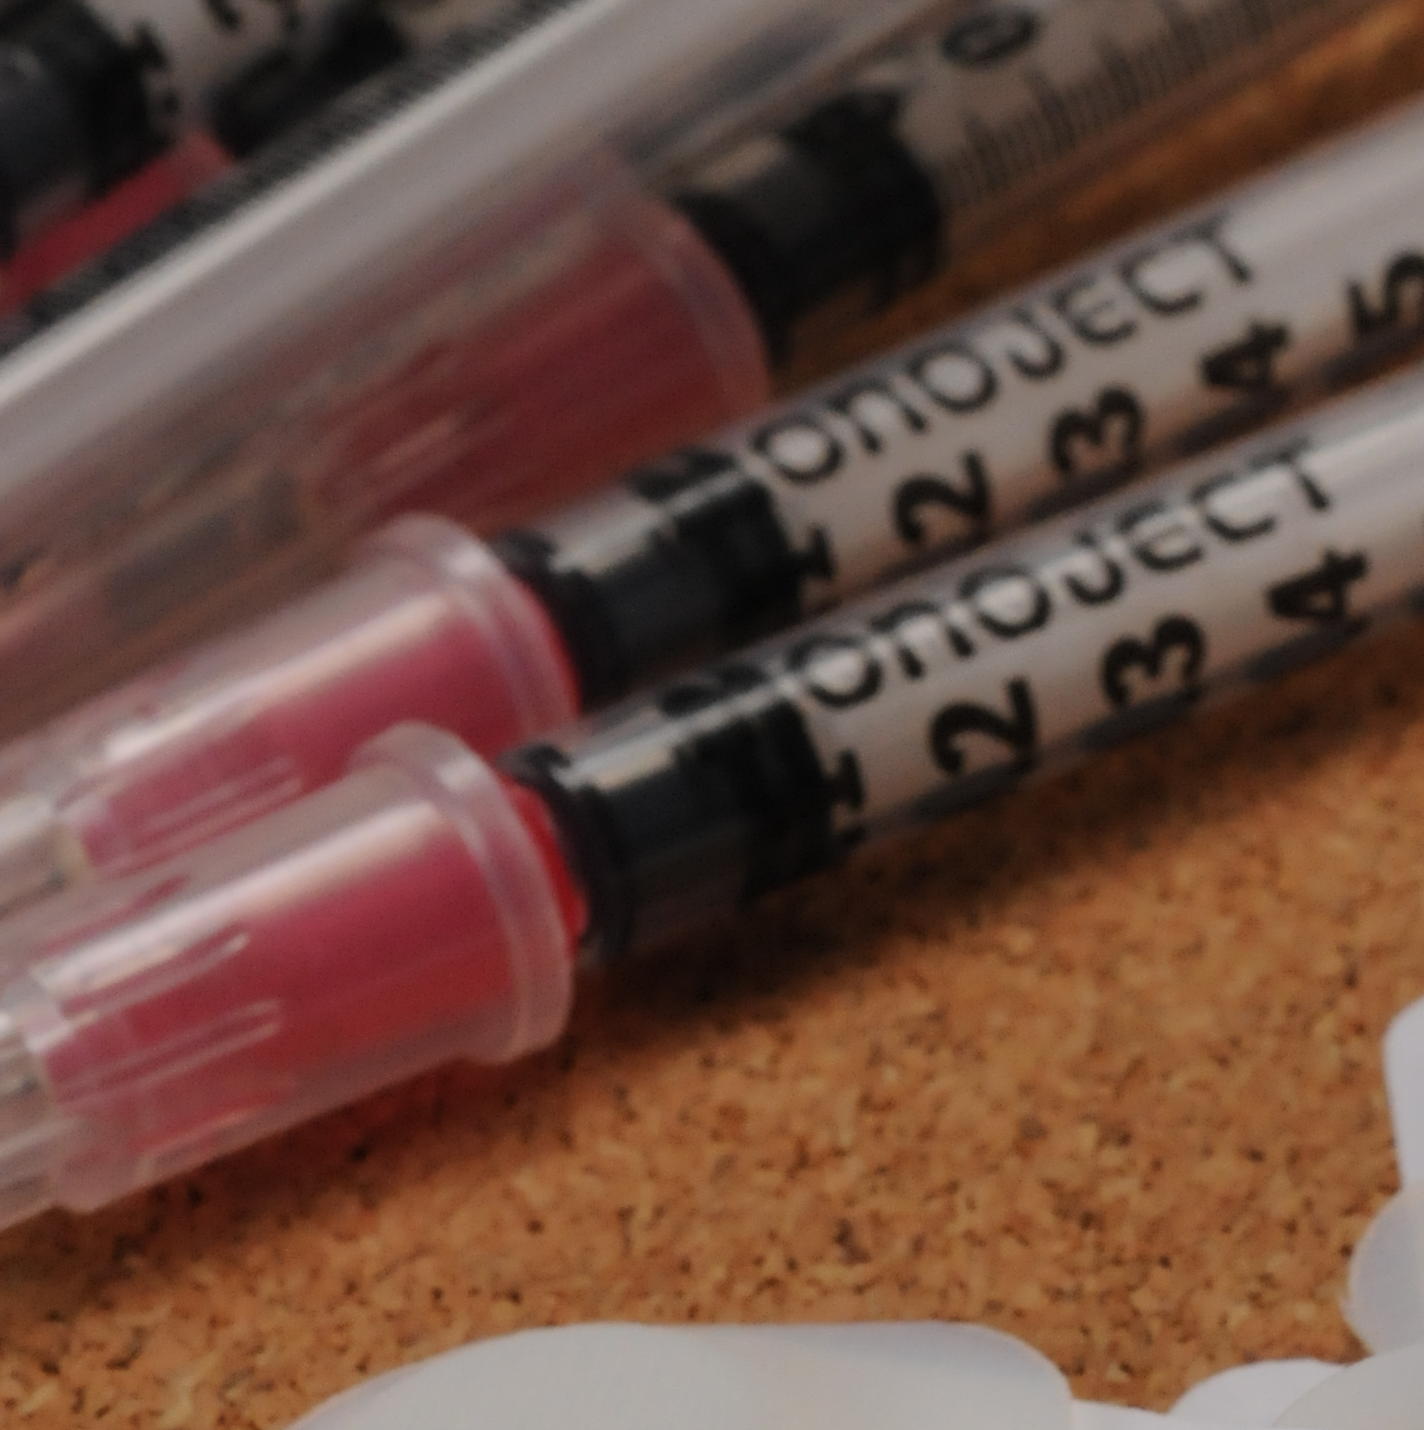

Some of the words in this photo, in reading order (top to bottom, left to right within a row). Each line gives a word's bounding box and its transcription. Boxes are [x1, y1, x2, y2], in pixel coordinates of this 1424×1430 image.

[891, 449, 991, 549] 2
[1050, 387, 1142, 477] 3
[930, 676, 1038, 774] 2
[1101, 615, 1206, 707] 3
